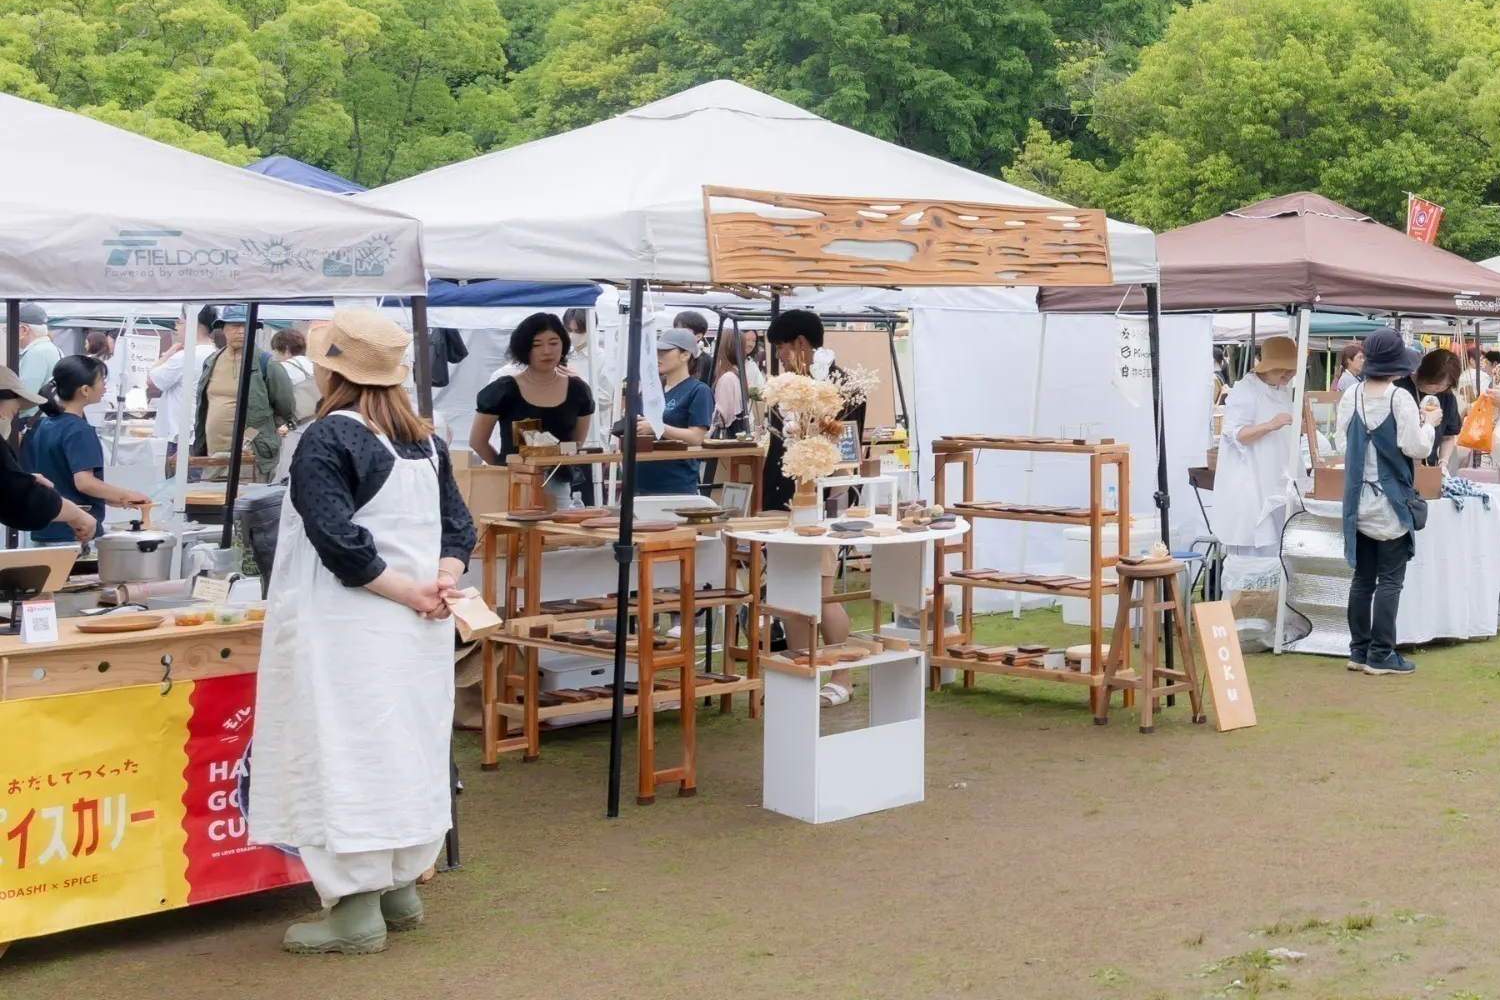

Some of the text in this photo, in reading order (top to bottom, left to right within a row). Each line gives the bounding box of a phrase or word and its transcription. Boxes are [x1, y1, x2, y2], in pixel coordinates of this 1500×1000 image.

[134, 248, 239, 266] FIELDOOR
[159, 267, 172, 278] by
[7, 758, 139, 795] おだしでつくった
[209, 758, 251, 782] HA
[0, 793, 155, 870] イスカリー
[63, 873, 99, 889] SPICE
